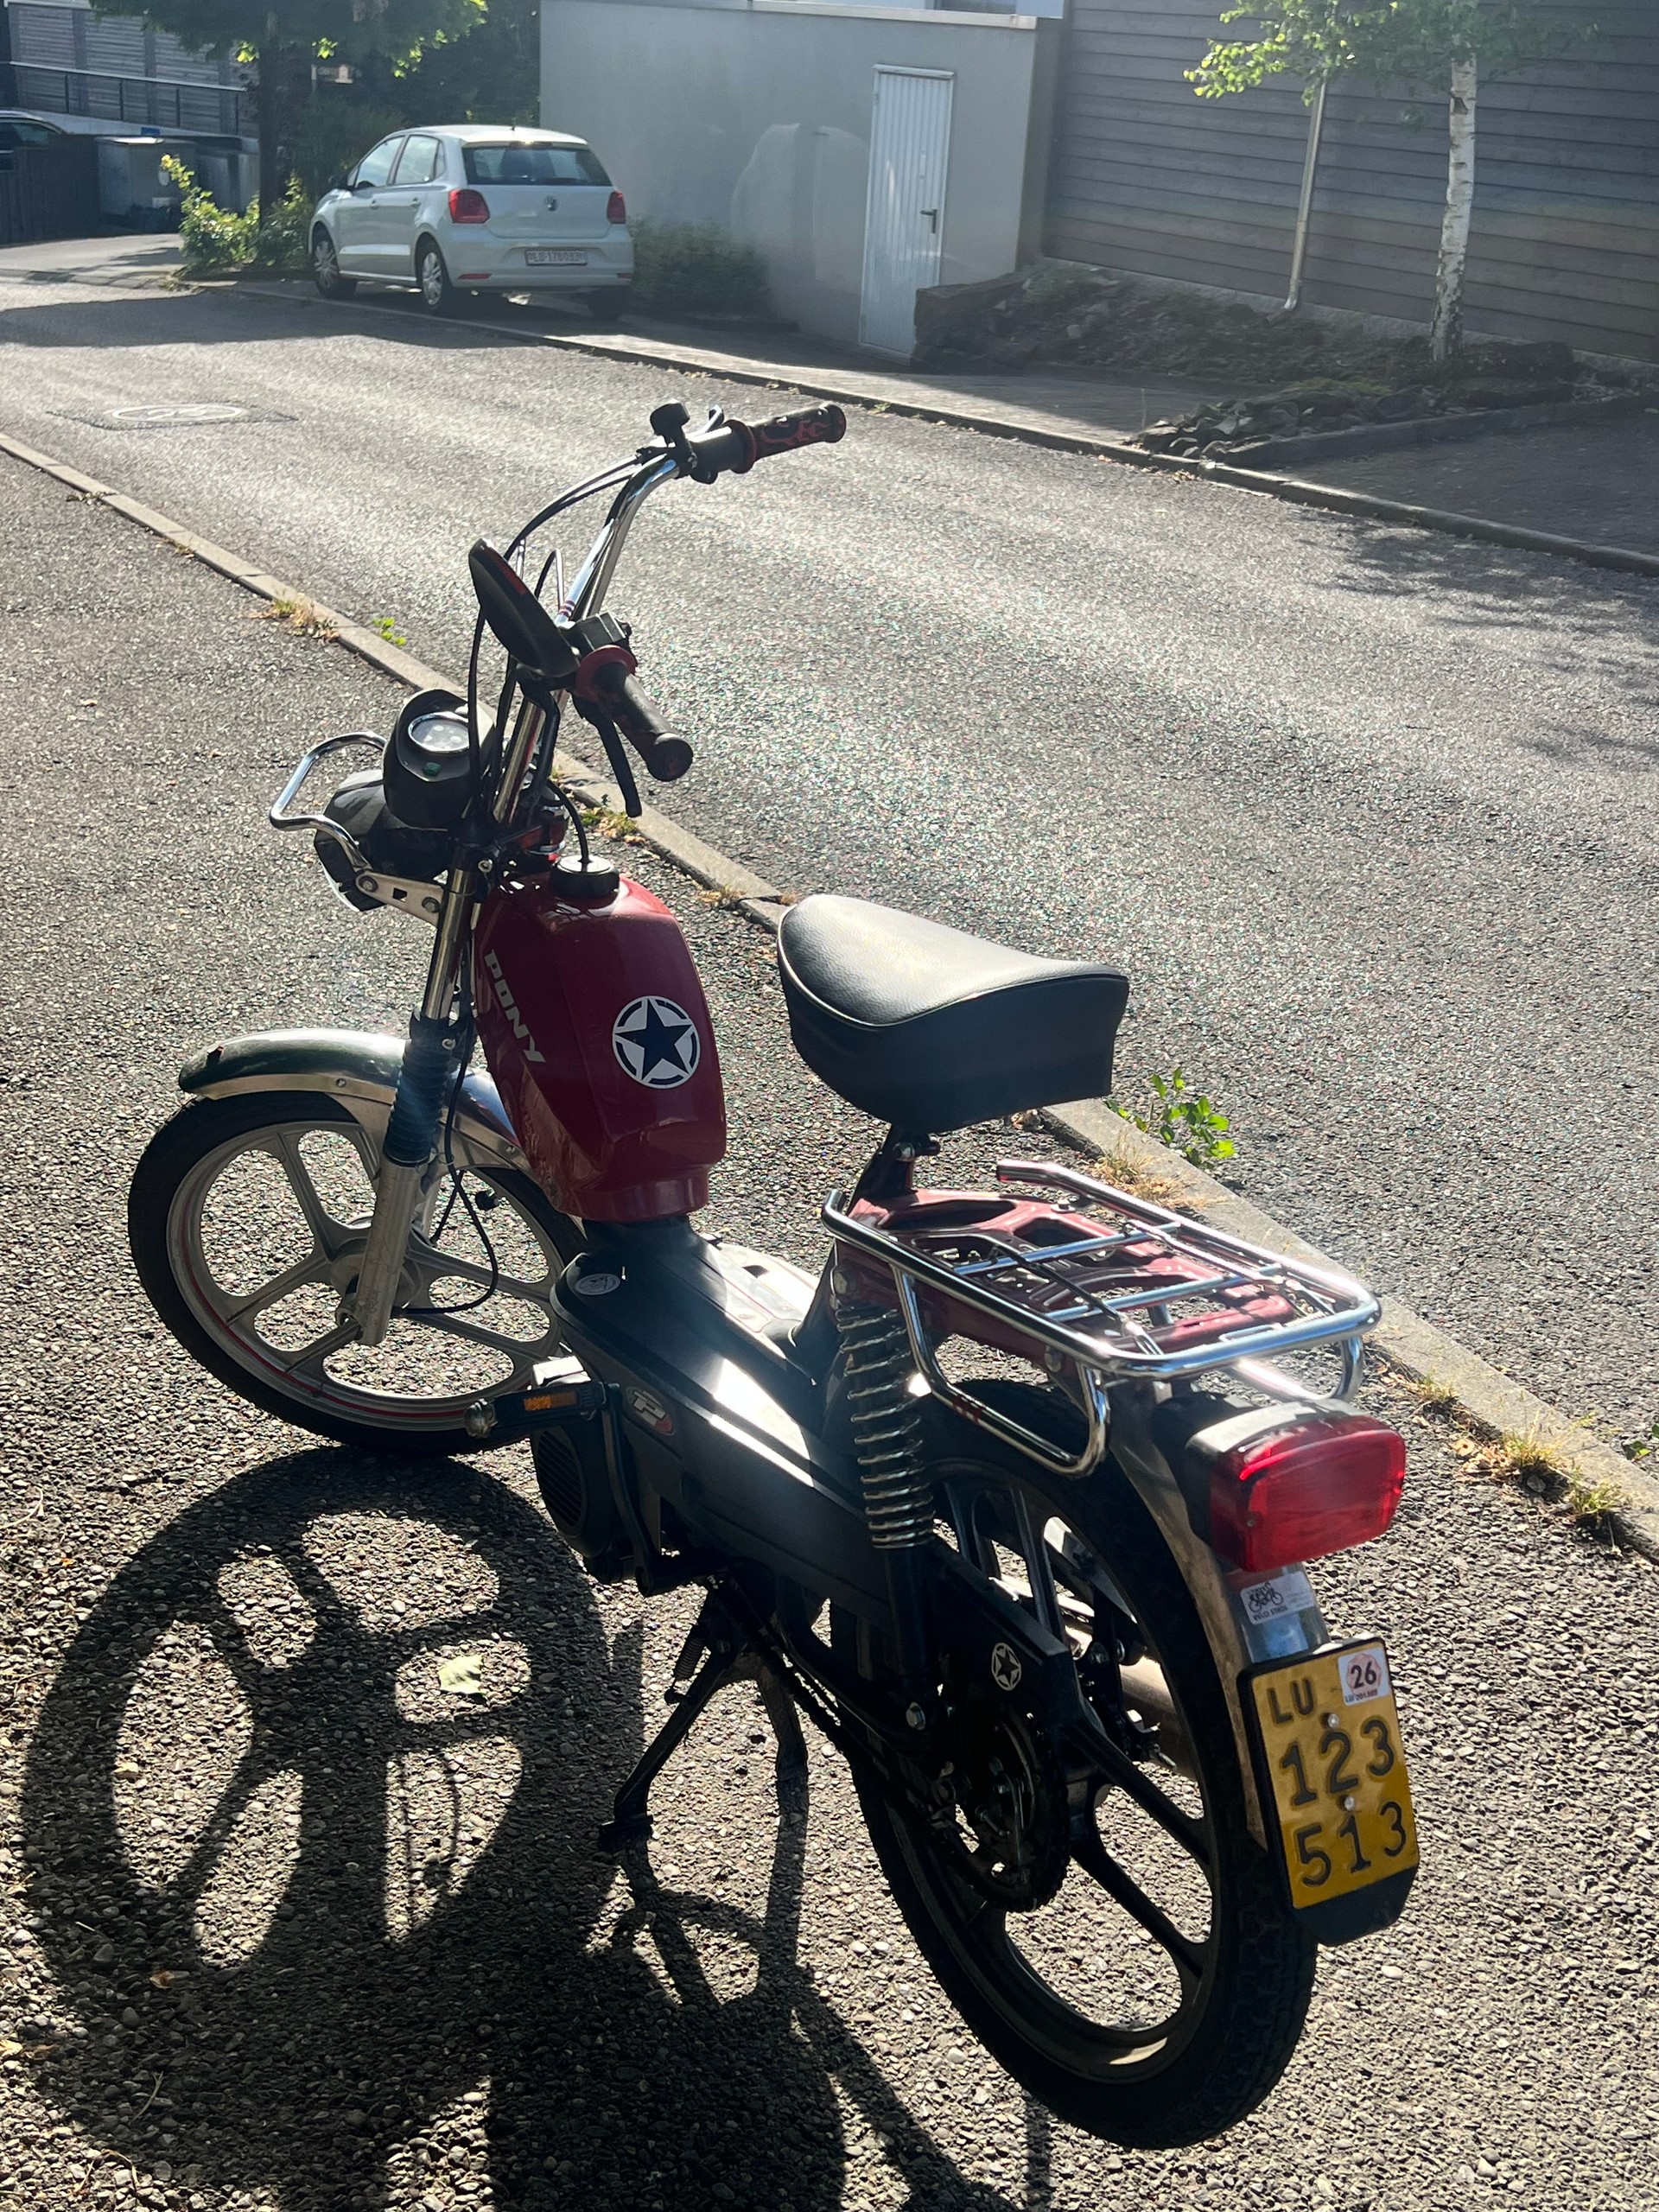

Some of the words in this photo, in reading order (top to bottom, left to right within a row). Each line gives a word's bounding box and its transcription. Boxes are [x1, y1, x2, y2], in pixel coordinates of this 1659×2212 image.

[483, 950, 546, 1062] PONY
[1268, 1679, 1314, 1725] LU
[1351, 1660, 1377, 1689] 26
[1281, 1718, 1395, 1807] 123
[1297, 1802, 1407, 1886] 513
